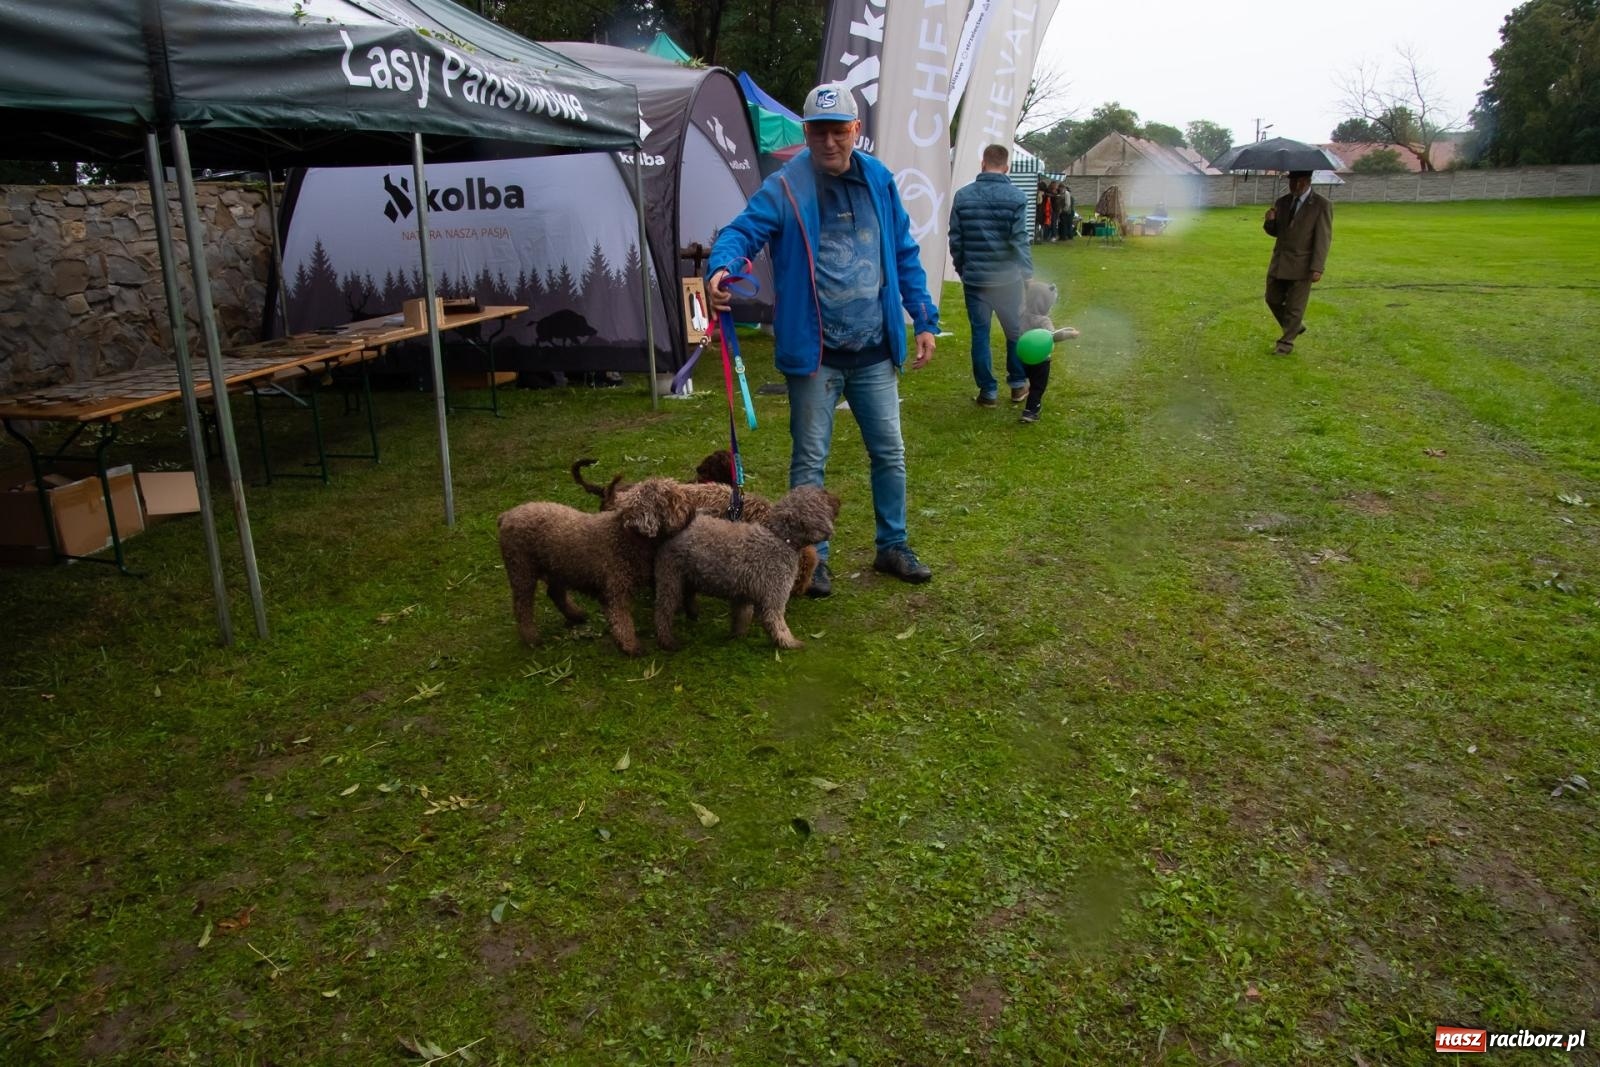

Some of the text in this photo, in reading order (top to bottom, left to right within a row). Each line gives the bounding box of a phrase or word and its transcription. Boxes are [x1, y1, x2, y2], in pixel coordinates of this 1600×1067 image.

[339, 30, 430, 109] Lasy
[424, 176, 525, 213] kolba
[402, 229, 442, 241] NATRA
